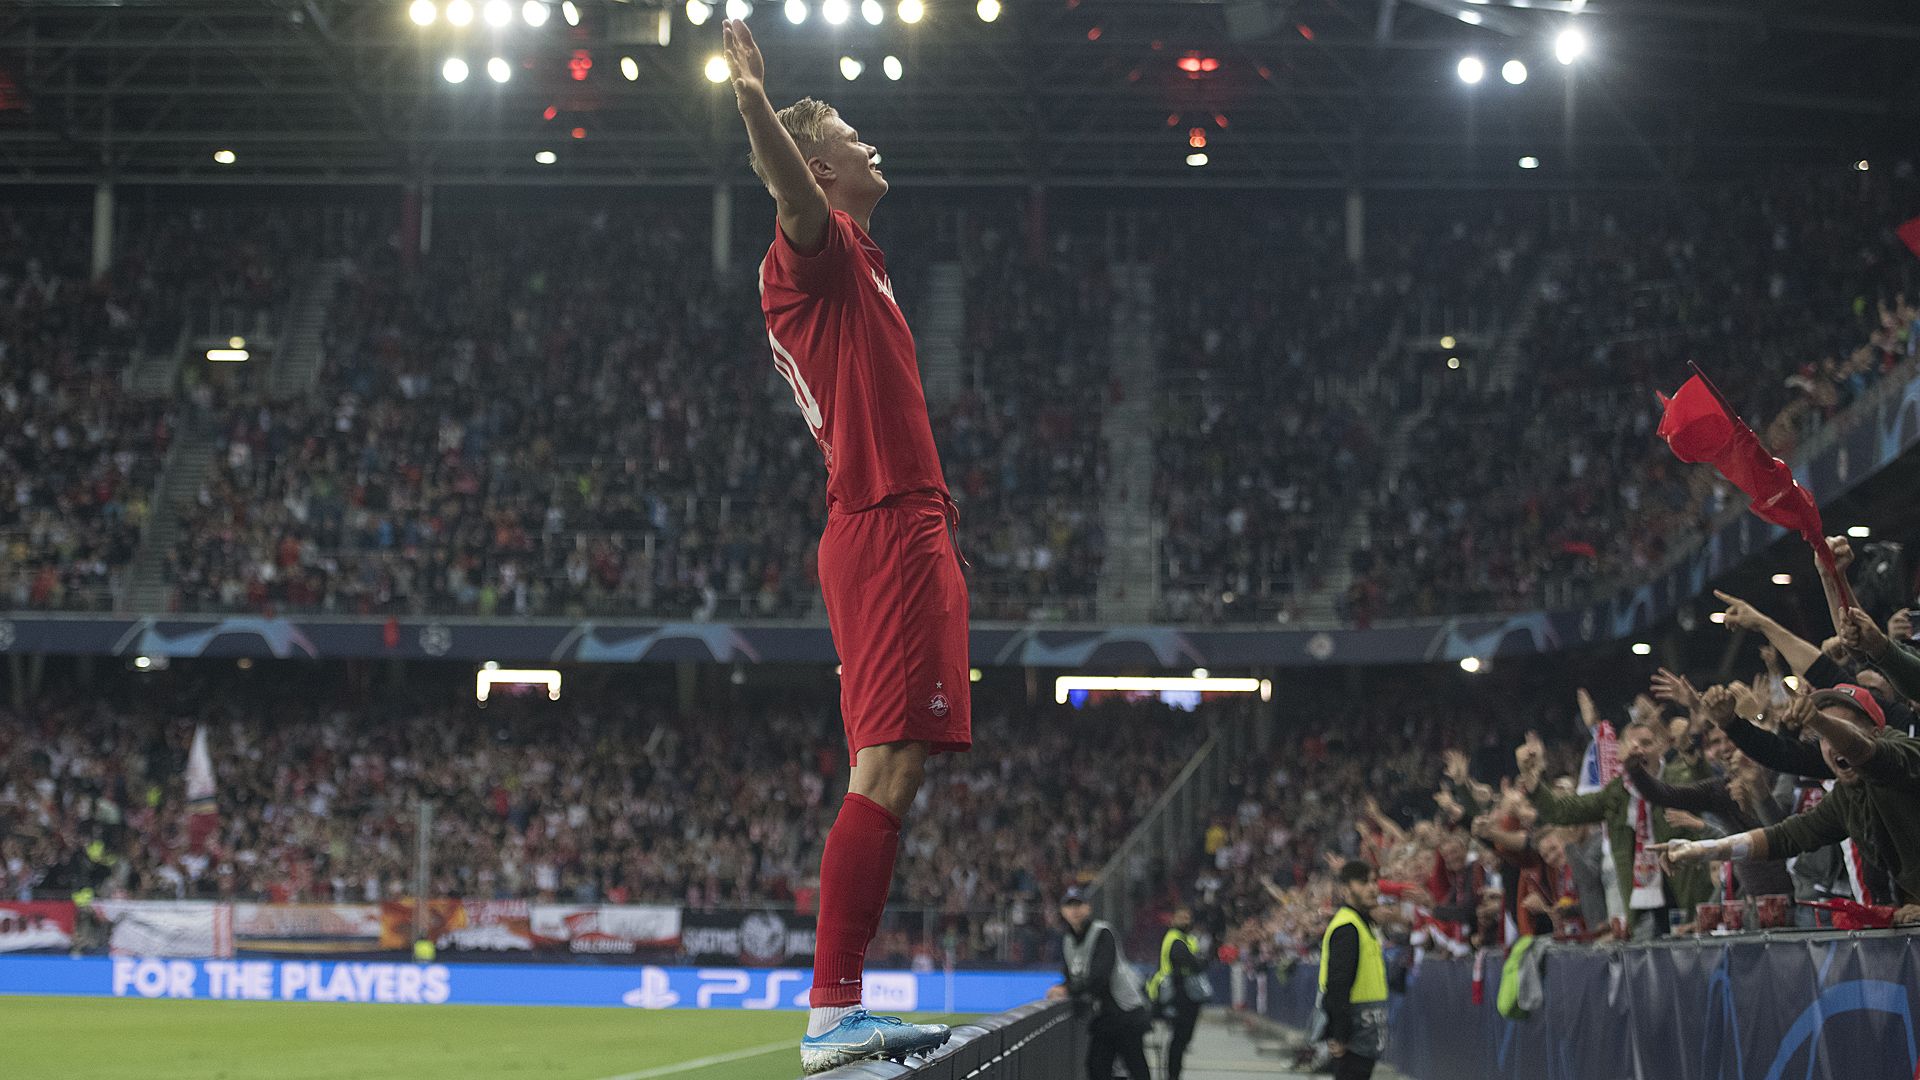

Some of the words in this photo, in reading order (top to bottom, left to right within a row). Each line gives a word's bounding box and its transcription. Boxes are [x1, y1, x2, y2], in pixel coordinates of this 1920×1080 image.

[113, 958, 196, 998] FOR
[204, 961, 273, 999] THE
[281, 961, 450, 1004] PLAYERS
